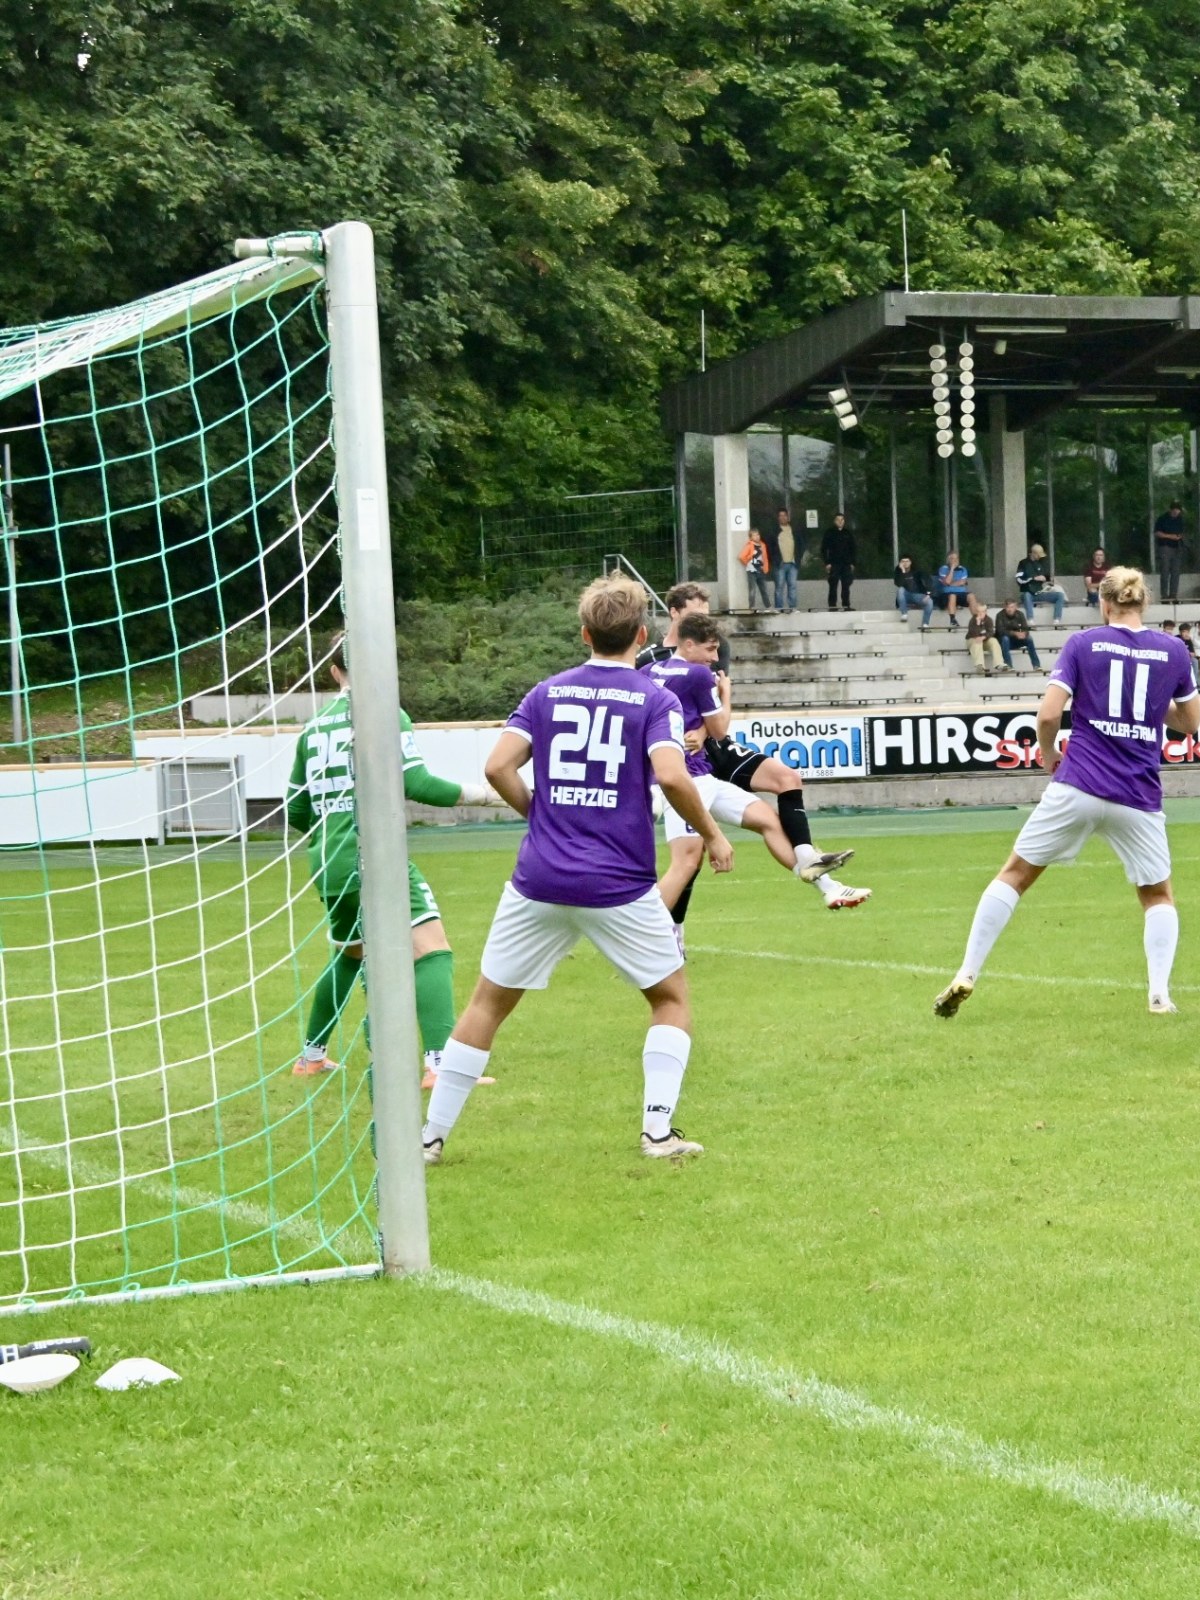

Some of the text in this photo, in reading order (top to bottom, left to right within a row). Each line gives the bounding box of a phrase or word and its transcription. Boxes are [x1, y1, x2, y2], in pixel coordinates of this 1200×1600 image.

[734, 515, 743, 525] C
[547, 685, 646, 706] SCHWABEN AUGSBURG
[1108, 658, 1150, 722] 11
[306, 727, 355, 796] 25
[549, 703, 627, 784] 24
[550, 785, 618, 809] HERZIG
